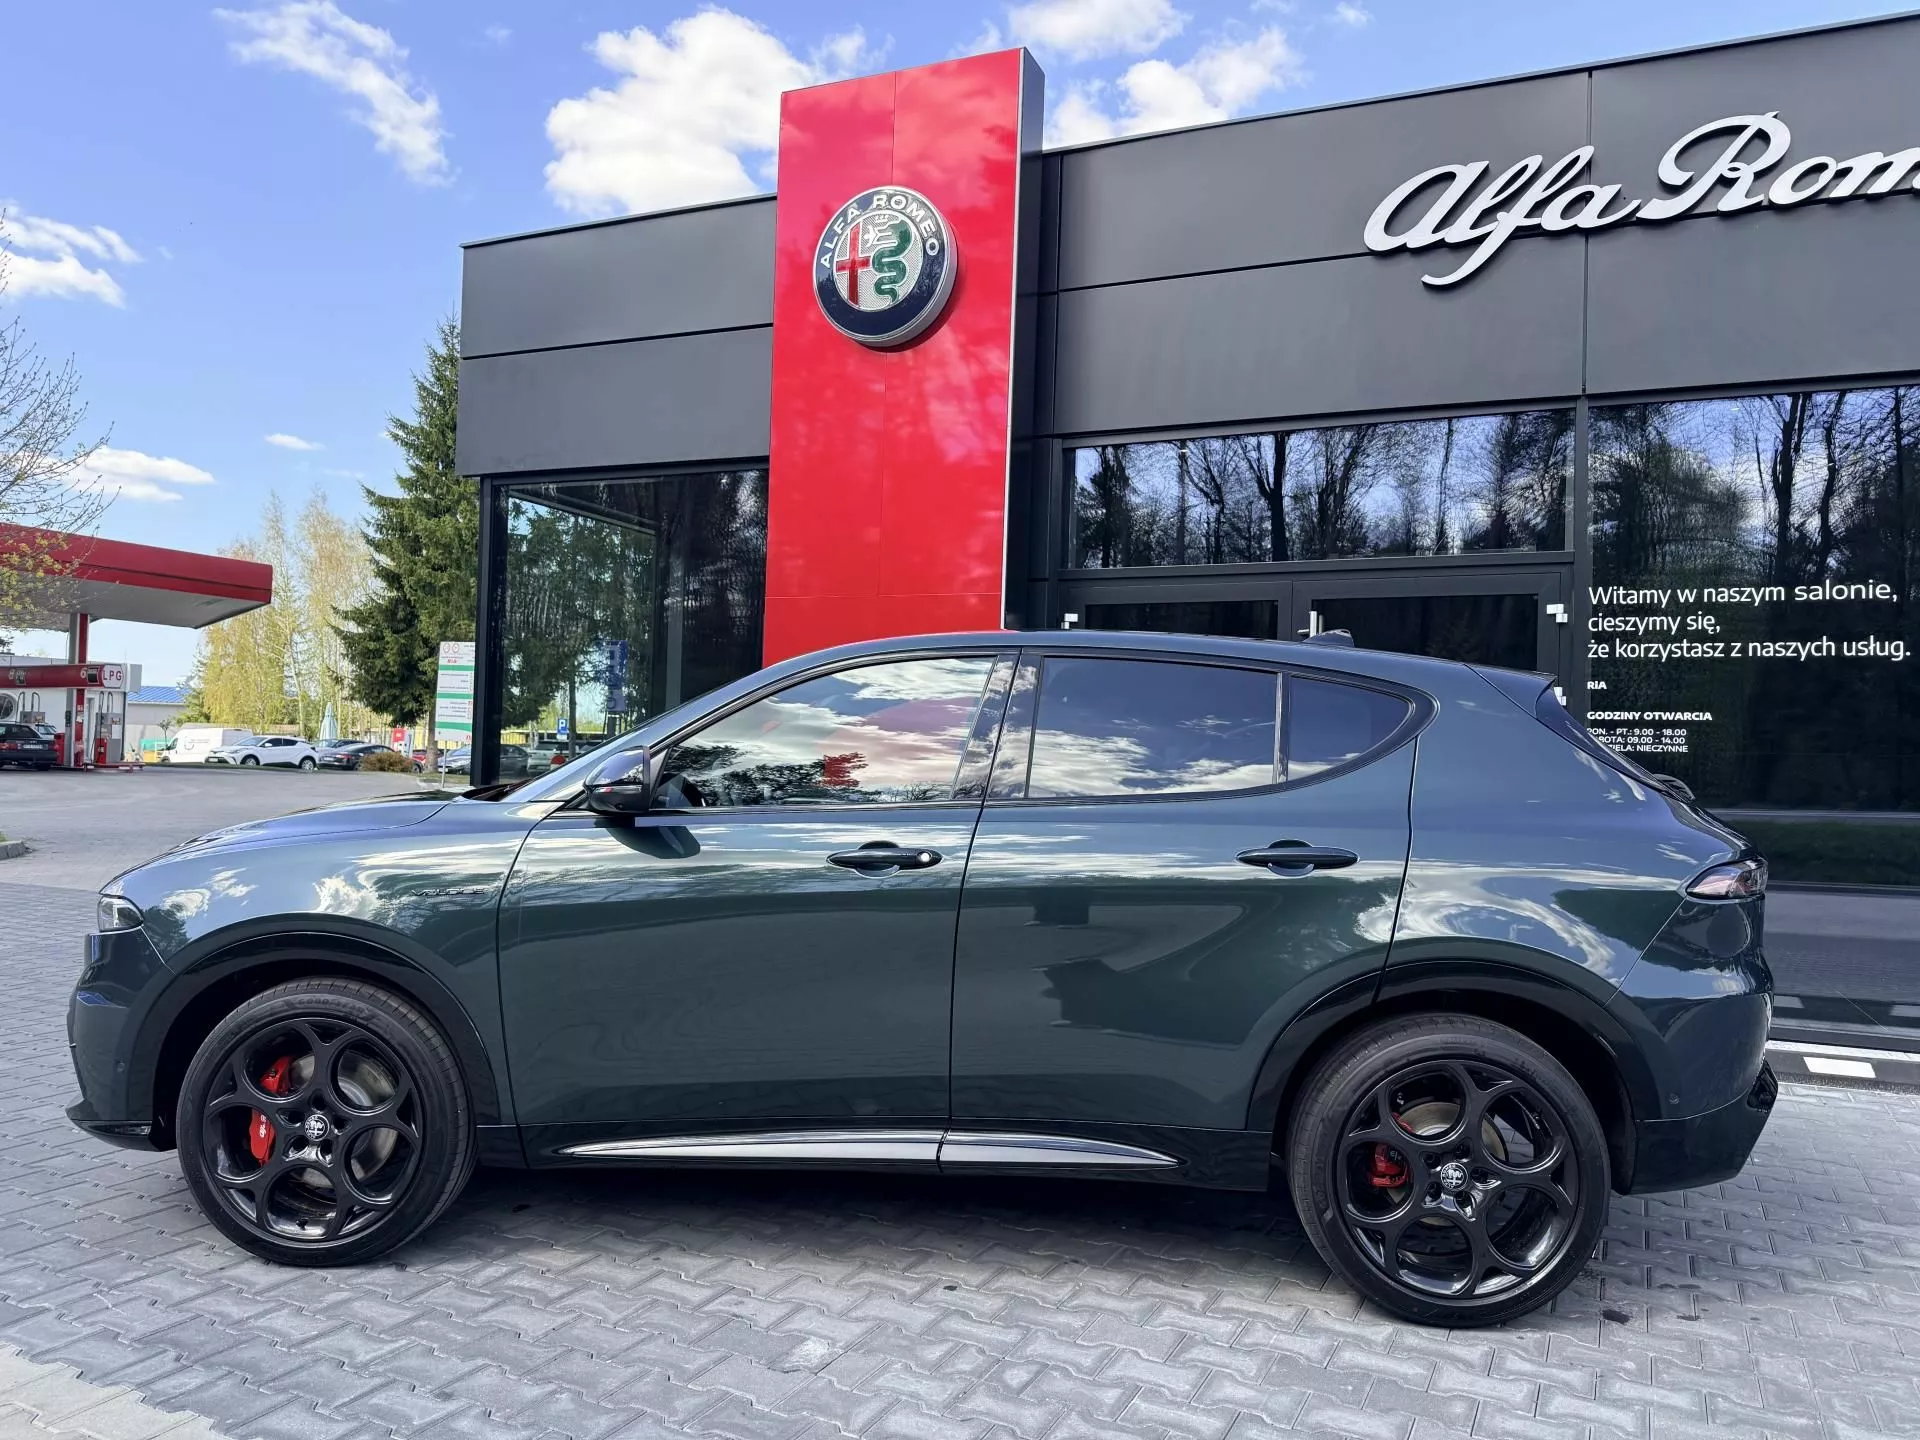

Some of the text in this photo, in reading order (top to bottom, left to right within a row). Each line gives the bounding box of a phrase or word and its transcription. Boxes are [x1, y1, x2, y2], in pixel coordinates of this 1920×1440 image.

[1363, 145, 1639, 286] Alfa
[820, 194, 940, 269] ALFA ROMEO
[1588, 578, 1897, 608] Witamy w naszym salonie,
[1588, 610, 1720, 635] cieszymy się,
[1587, 634, 1911, 662] że korzystasz z naszych usług.
[103, 670, 122, 681] LPG
[1587, 711, 1712, 721] GODZINY OTWARCIA
[1627, 736, 1653, 744] 09.00
[1661, 736, 1685, 744] 14.00
[1634, 728, 1654, 736] 9.00
[1662, 728, 1687, 736] 18.00
[1636, 744, 1689, 753] NIECZYNNE
